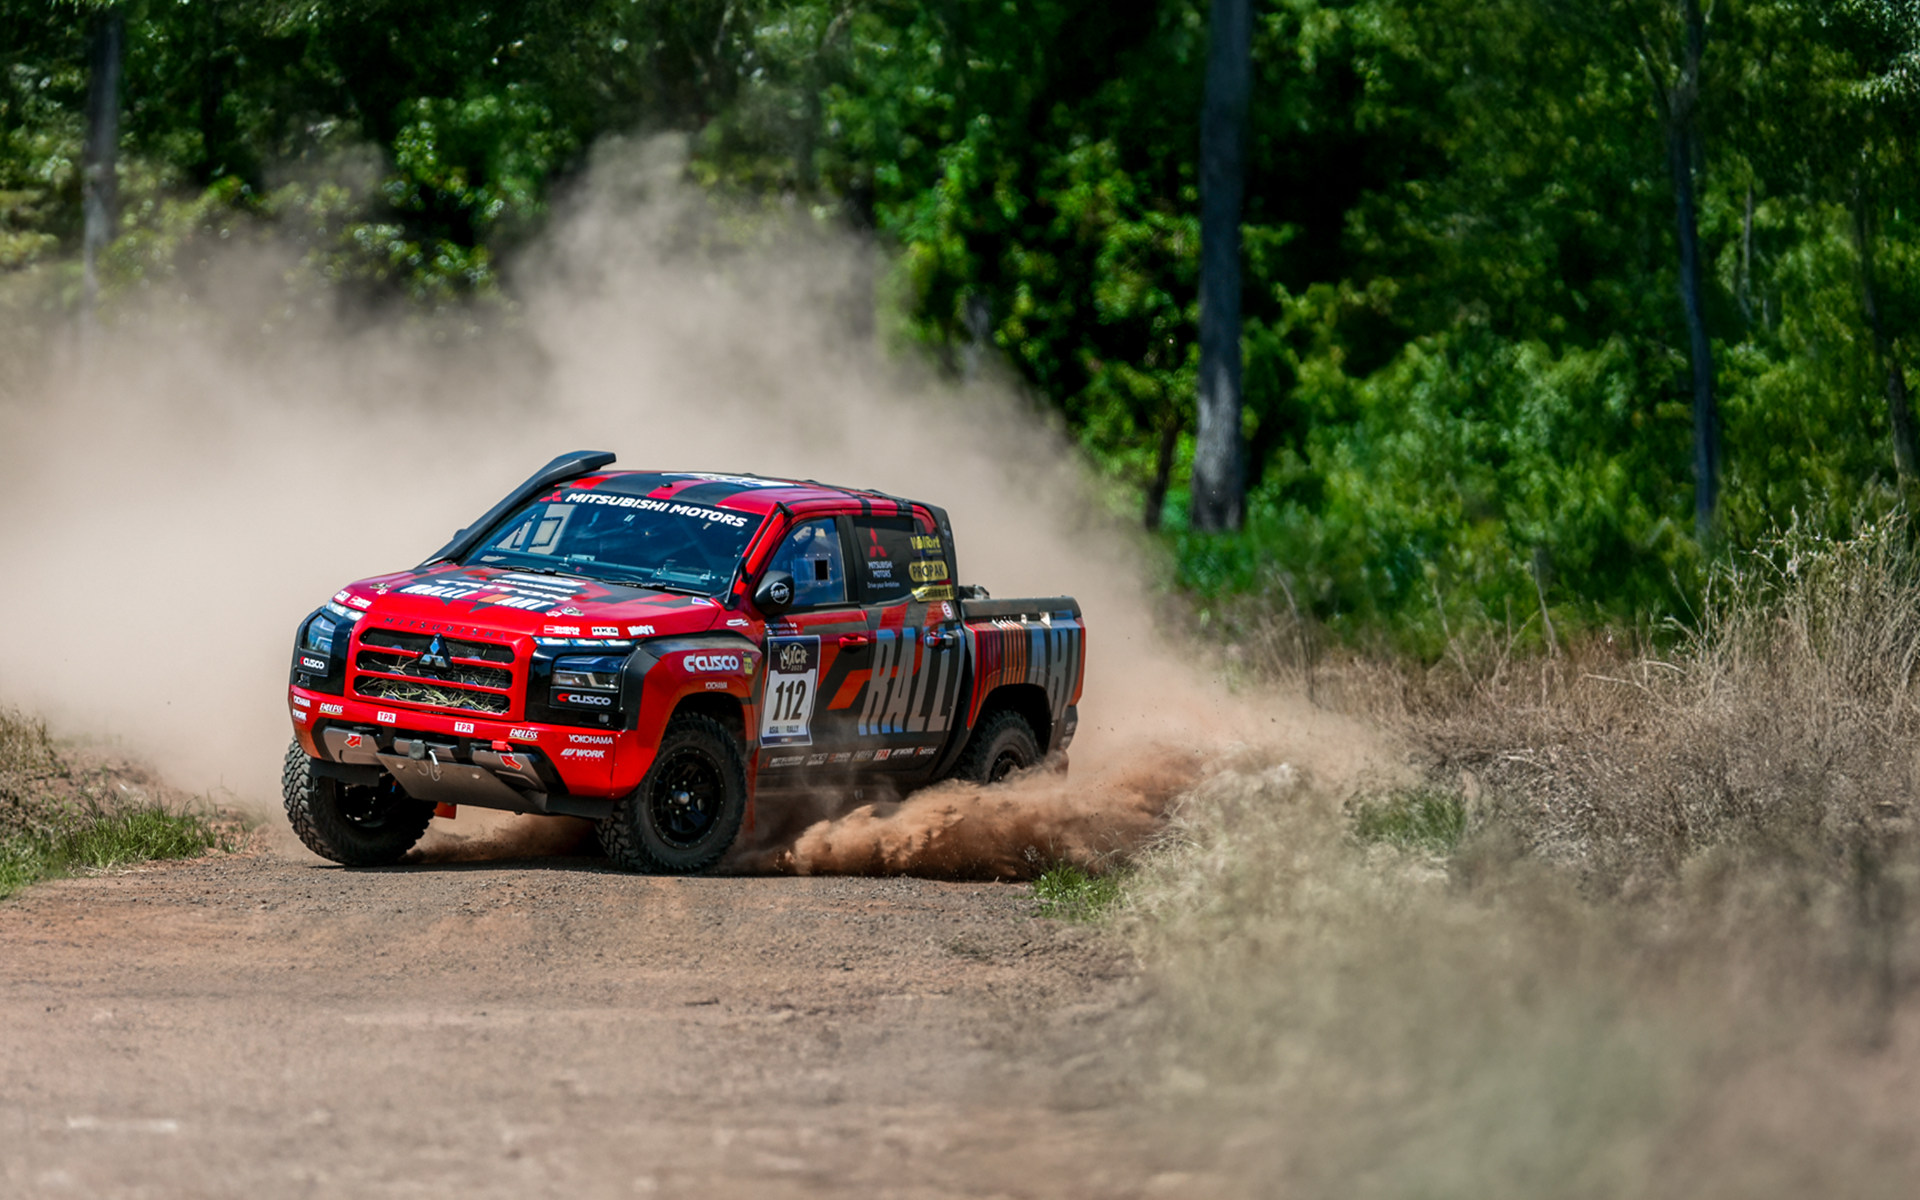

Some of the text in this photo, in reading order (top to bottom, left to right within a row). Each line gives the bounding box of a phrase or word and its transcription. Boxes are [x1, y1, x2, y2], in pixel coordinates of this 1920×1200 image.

[565, 493, 748, 527] MITSUBISHI MOTORS
[867, 561, 893, 569] MITSUBISHI
[872, 570, 892, 578] MOTORS
[912, 564, 945, 578] PROPAK
[384, 617, 504, 638] MITSUBISHI
[303, 657, 325, 670] CUSCO
[695, 655, 739, 671] CUSCO
[568, 694, 612, 706] CUSCO
[772, 680, 807, 721] 112
[319, 702, 344, 713] ENDLESS
[379, 712, 395, 722] TPR
[457, 723, 472, 732] TPR
[768, 725, 780, 734] ASIA
[786, 725, 800, 733] RALLY
[509, 728, 538, 739] ENDLESS
[568, 734, 614, 745] YOKOHAMA
[576, 749, 605, 758] WORK
